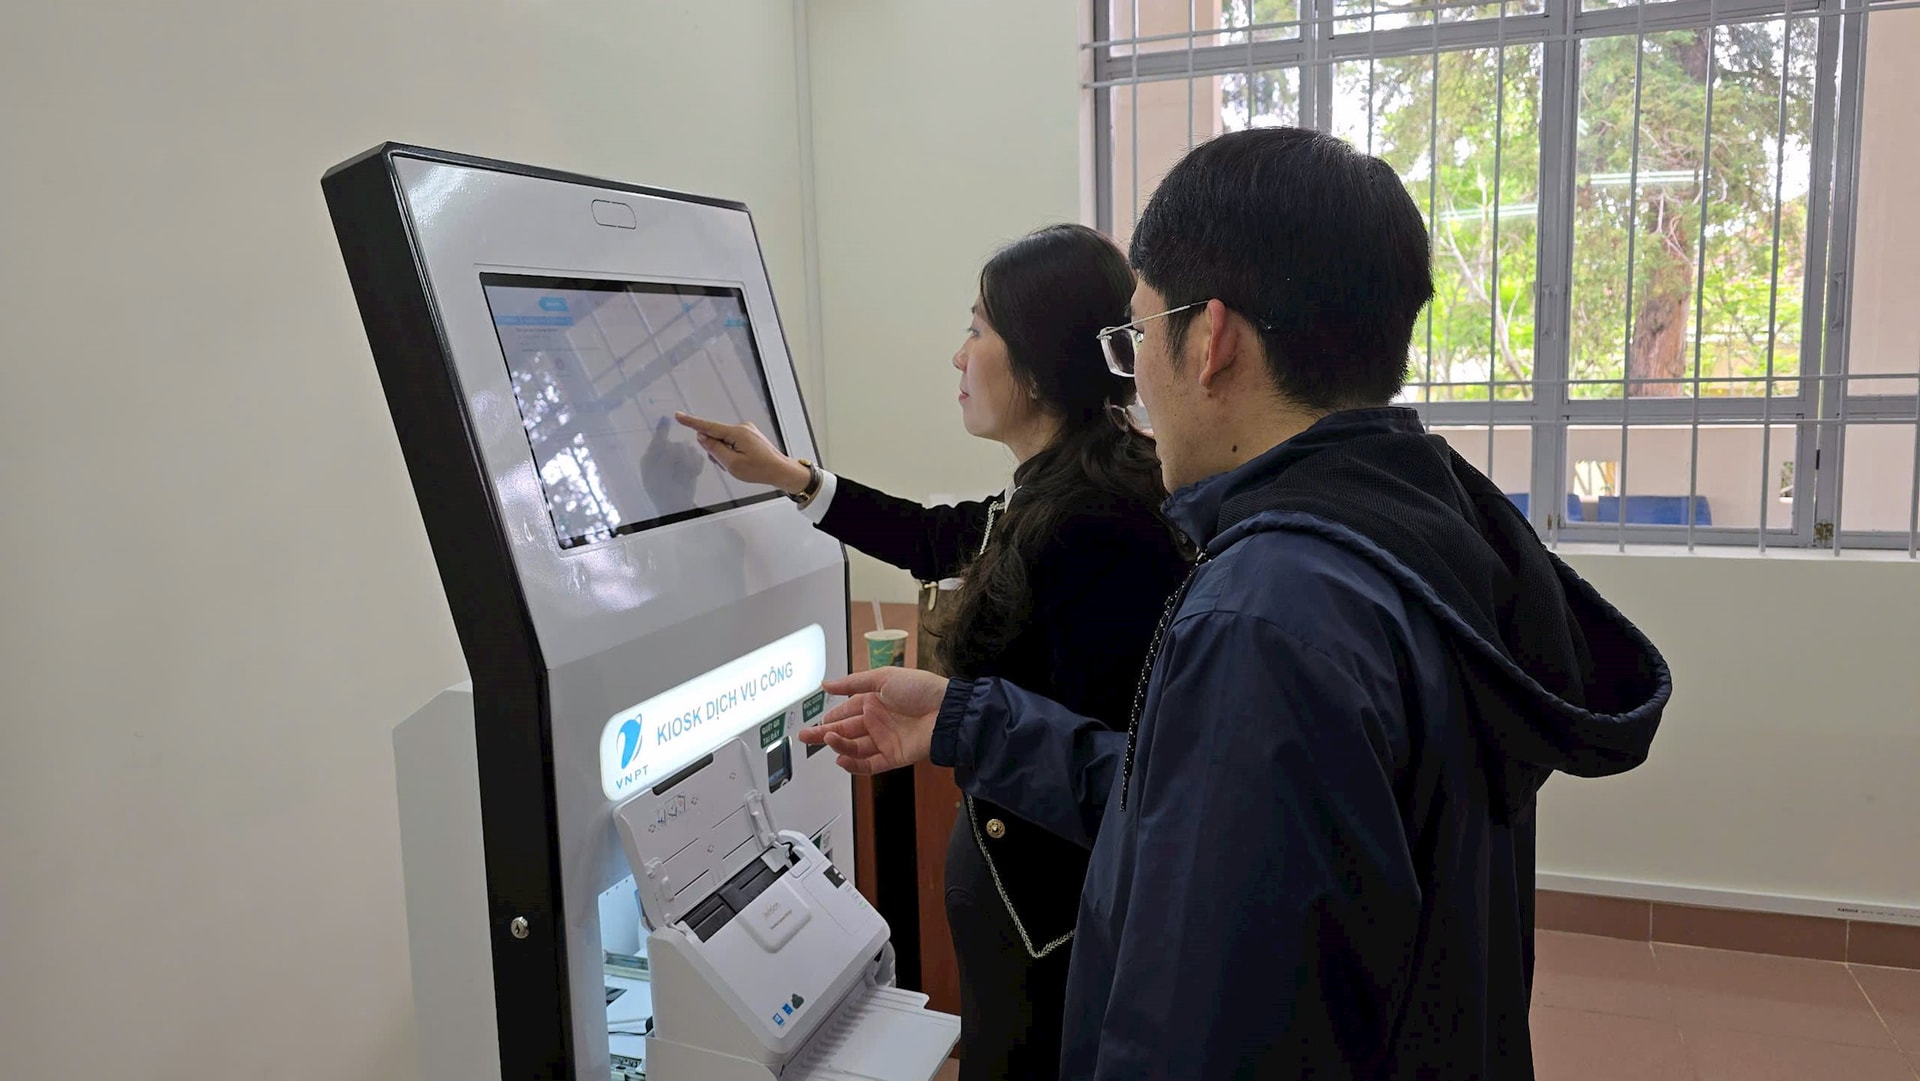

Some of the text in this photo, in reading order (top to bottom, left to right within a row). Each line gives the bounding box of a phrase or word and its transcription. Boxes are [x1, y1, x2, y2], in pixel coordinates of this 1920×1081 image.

[657, 661, 793, 745] KIOSK DỊCH VỤ CÔNG
[615, 764, 649, 789] VNPT
